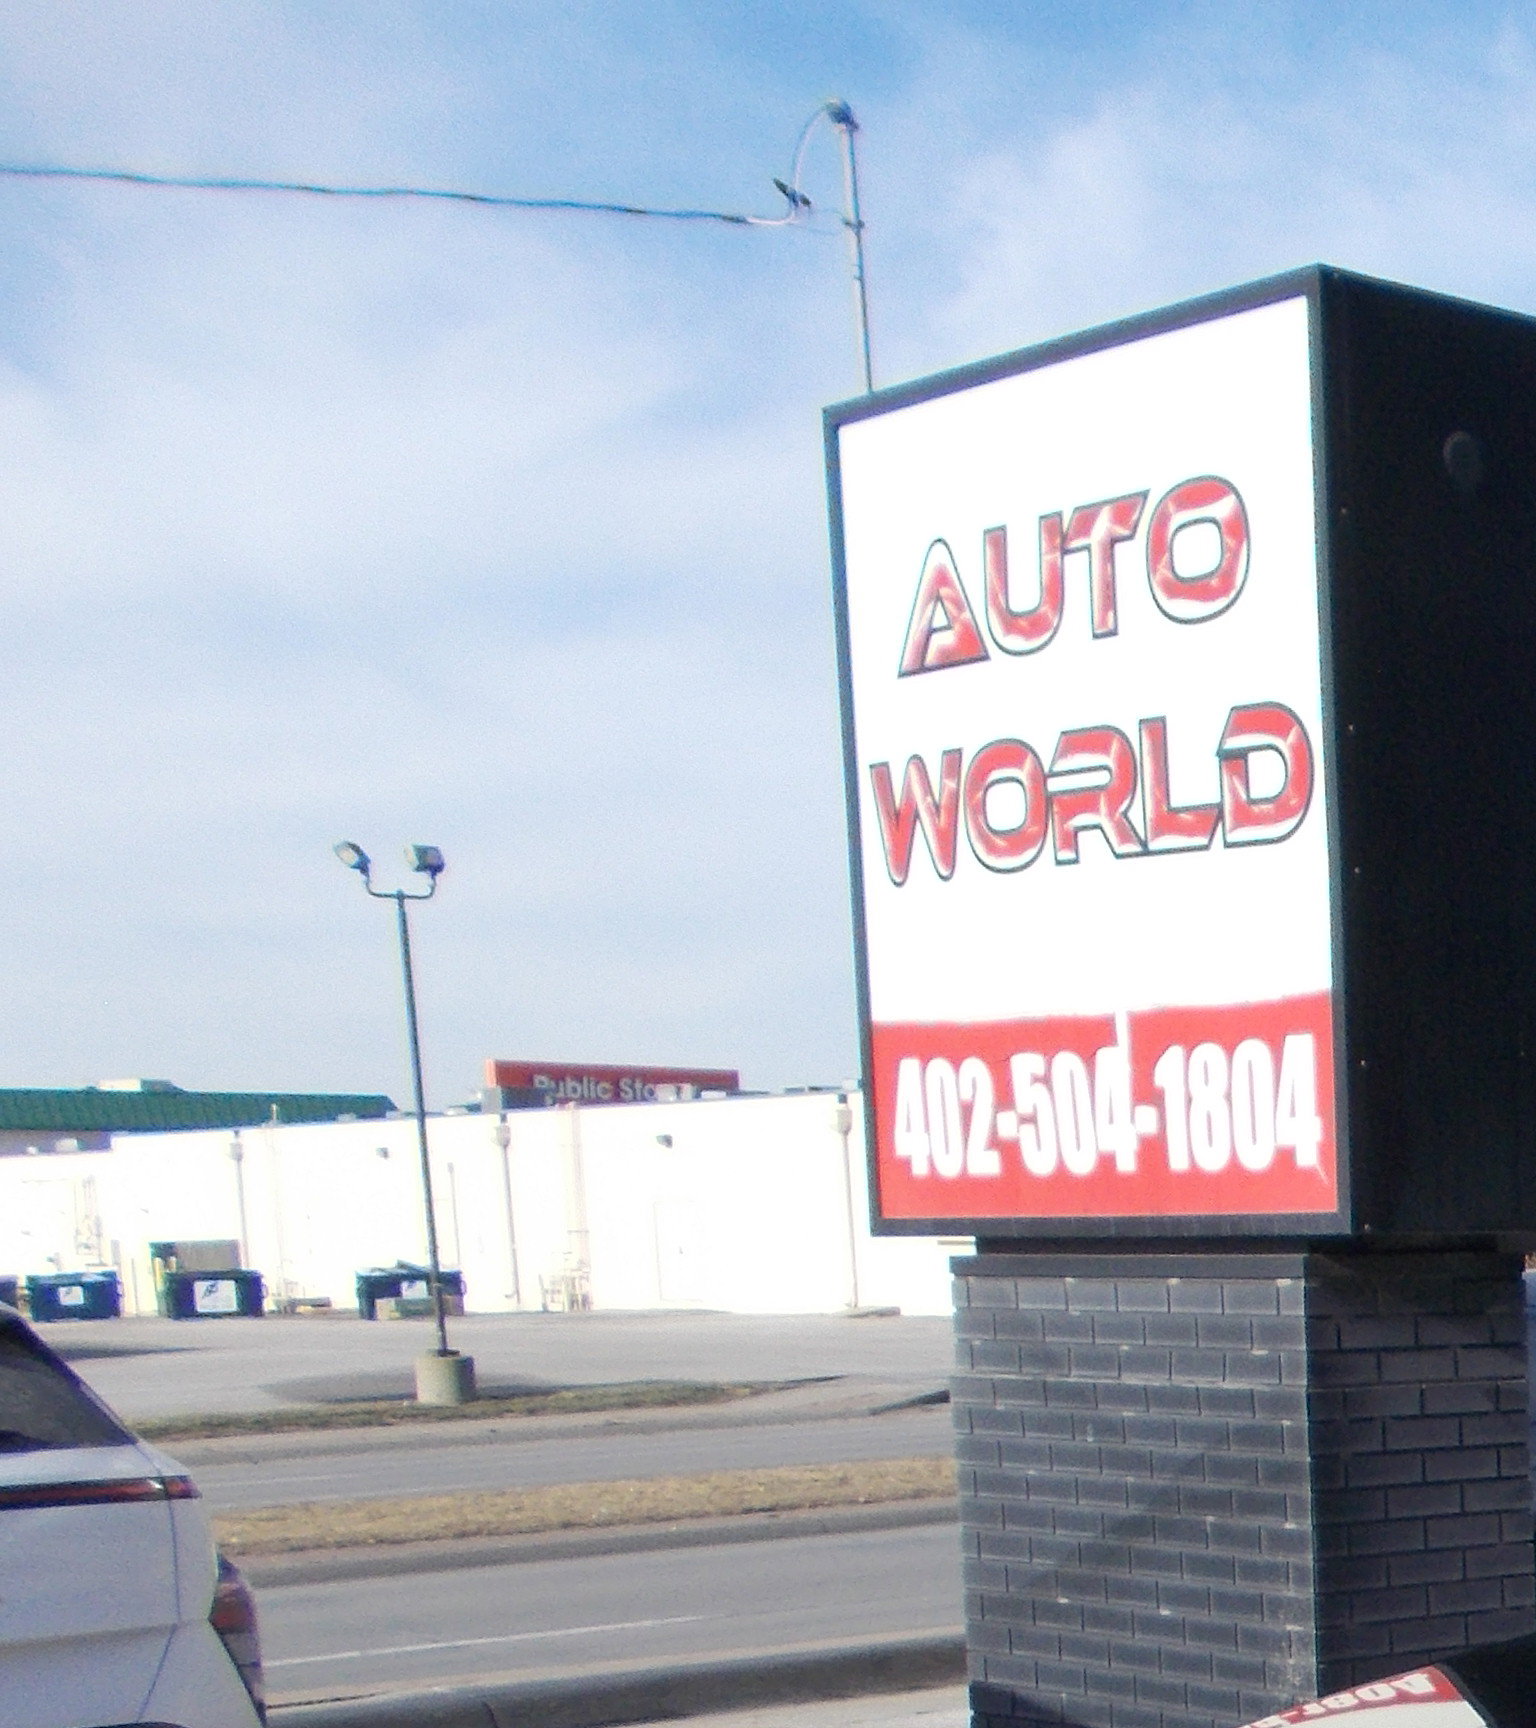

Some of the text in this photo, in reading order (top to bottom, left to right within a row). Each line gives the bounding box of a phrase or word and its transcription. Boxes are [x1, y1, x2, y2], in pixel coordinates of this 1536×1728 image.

[896, 475, 1251, 679] AUTO
[868, 700, 1315, 887] WORLD
[893, 1032, 1322, 1180] 402-504-1804
